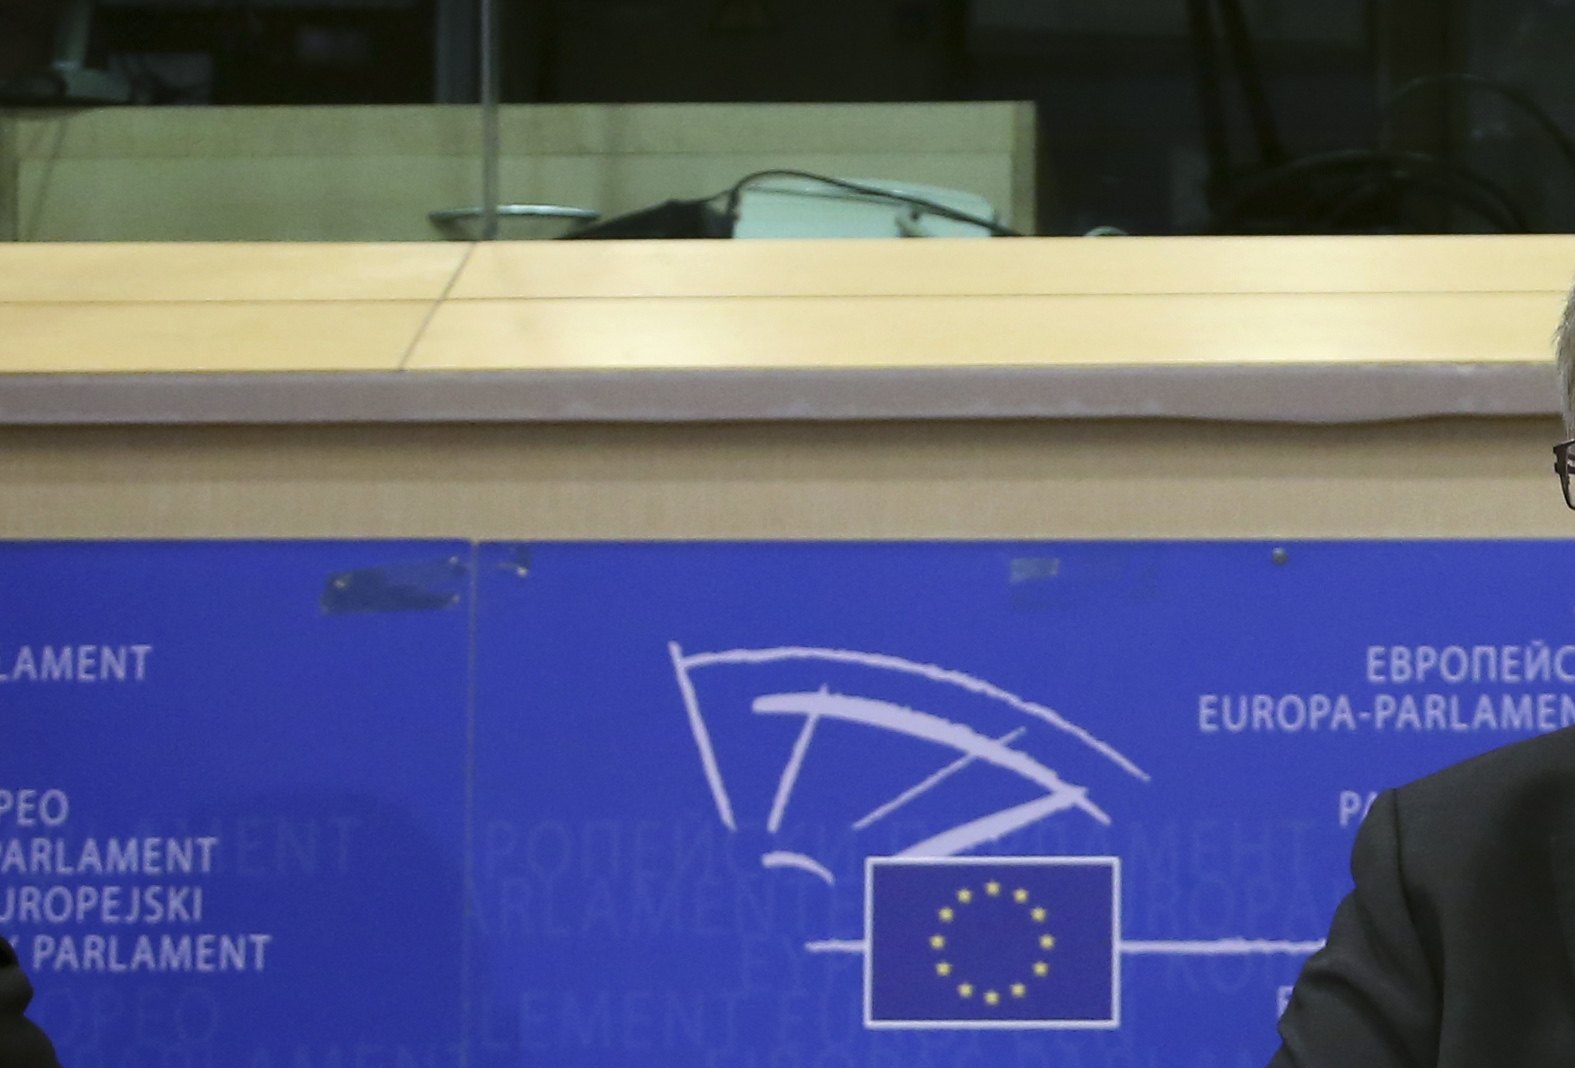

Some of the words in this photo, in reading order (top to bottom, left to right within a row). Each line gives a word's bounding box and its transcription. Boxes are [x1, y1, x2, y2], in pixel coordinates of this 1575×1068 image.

[0, 644, 152, 681] AMENT
[0, 837, 217, 874] ARLAMENT
[33, 934, 270, 971] PARLAMENT
